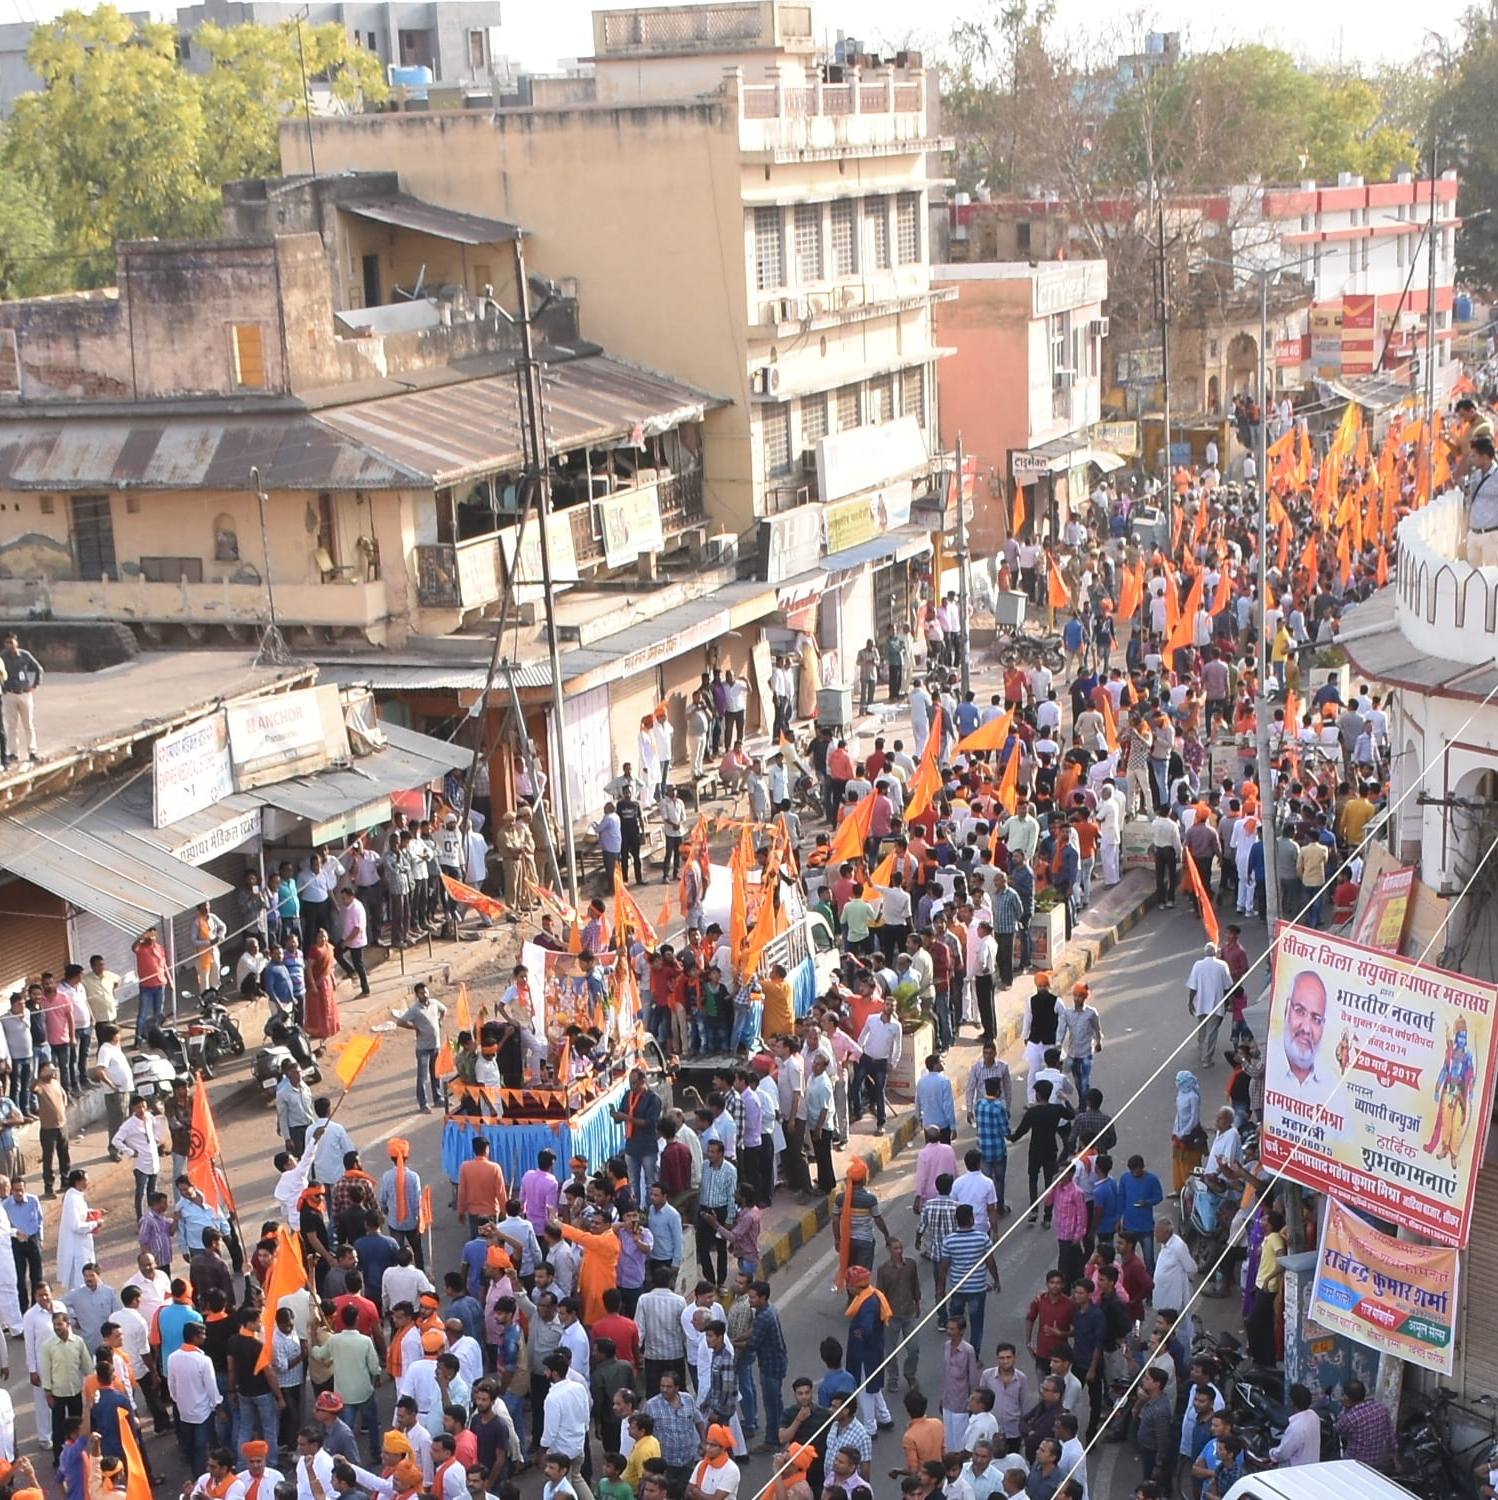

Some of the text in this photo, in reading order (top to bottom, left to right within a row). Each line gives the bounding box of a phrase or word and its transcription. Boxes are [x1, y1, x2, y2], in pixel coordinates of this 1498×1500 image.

[258, 706, 304, 731] ANCHOR
[1283, 935, 1490, 1014] सीकर जिला संयुक्त व्यापार महासंघ
[1336, 988, 1436, 1032] भारतीय नववर्ष
[1347, 1082, 1373, 1098] समस्त
[1392, 1065, 1417, 1082] 2017
[1266, 1090, 1344, 1131] रामप्रसाद मिश्रा
[1354, 1097, 1388, 1120] व्यापारी
[1376, 1134, 1419, 1158] हार्दिक
[1361, 1147, 1457, 1198] शुभकामनाएं
[1324, 1247, 1371, 1284] राजेन्द्र
[1372, 1270, 1412, 1300] कुमार
[1413, 1285, 1449, 1314] शर्मा
